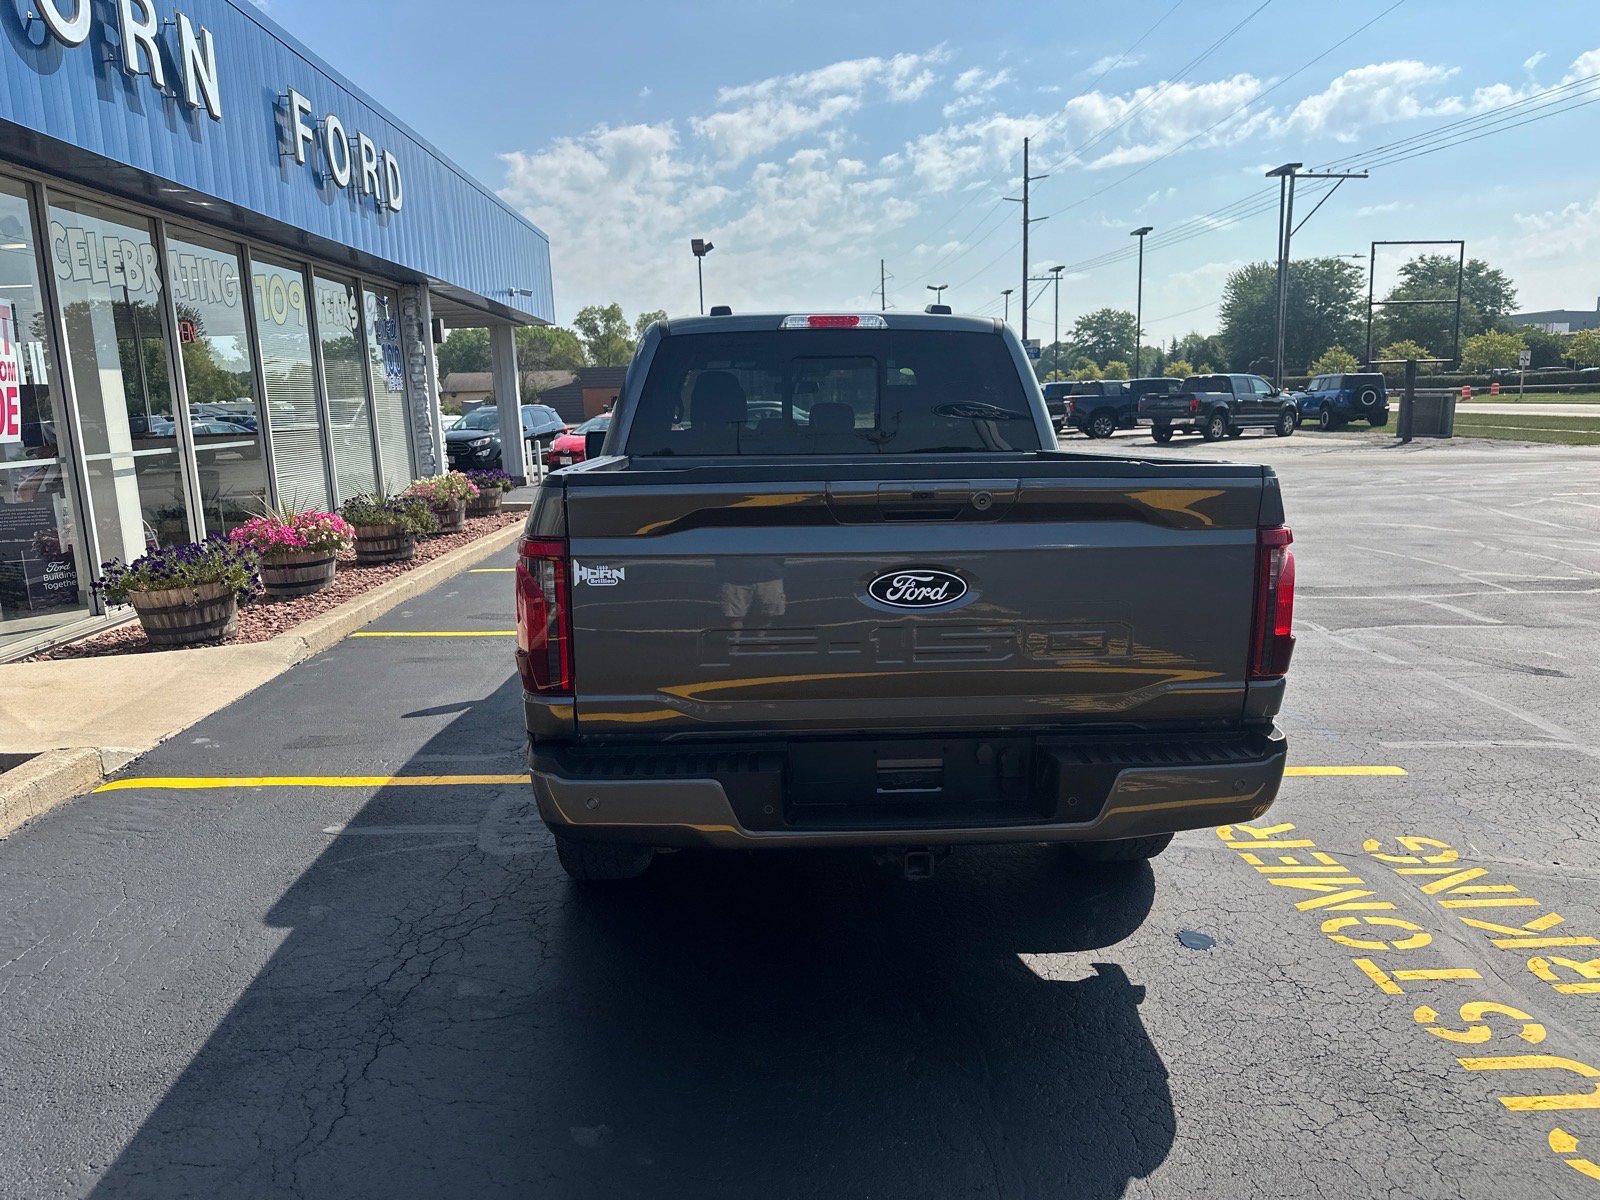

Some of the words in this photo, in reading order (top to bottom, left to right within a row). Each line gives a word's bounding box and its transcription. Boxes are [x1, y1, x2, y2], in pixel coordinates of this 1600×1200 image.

[288, 87, 402, 213] FORD
[254, 273, 304, 327] 109
[314, 286, 359, 330] YEARS
[43, 571, 76, 582] Building
[46, 561, 70, 573] Ford
[573, 559, 625, 587] HORN
[43, 579, 77, 590] Togethe
[886, 575, 949, 600] Ford
